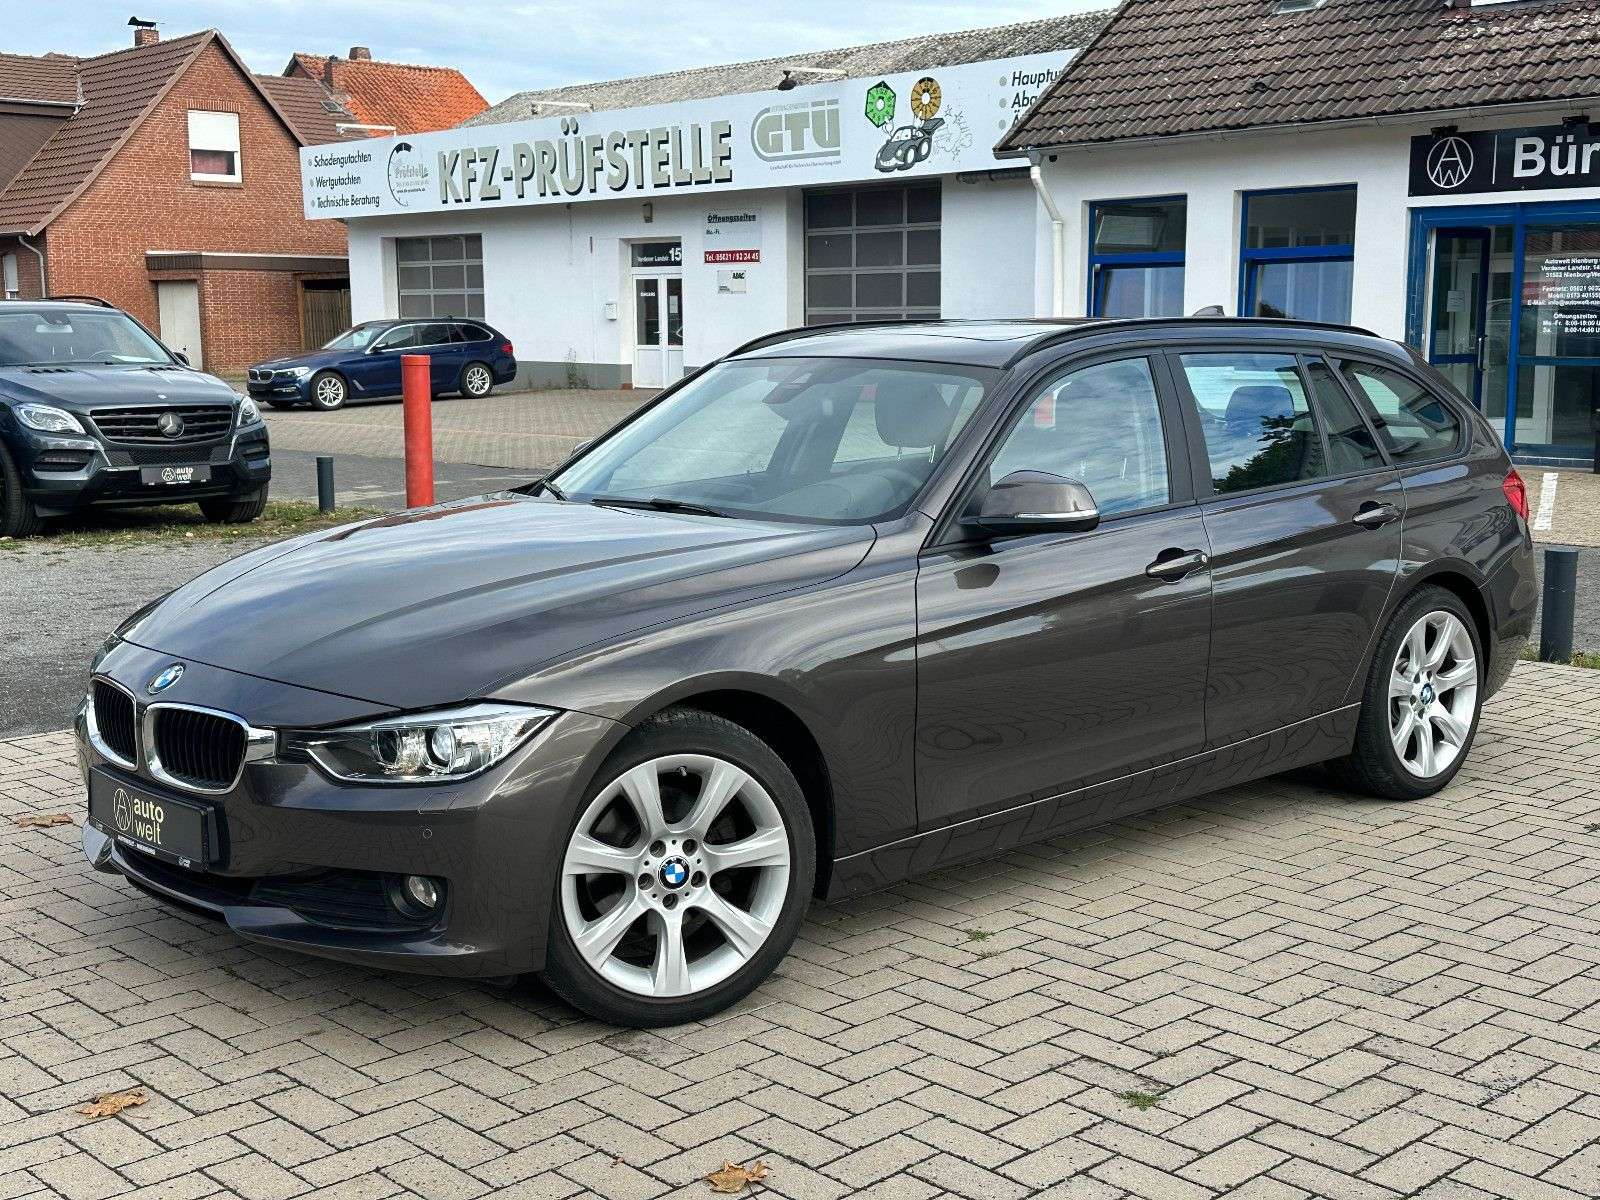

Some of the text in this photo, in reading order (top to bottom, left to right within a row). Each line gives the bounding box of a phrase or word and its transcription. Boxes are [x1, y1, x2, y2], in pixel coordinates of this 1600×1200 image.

[314, 150, 372, 168] Schadengutachten
[437, 116, 733, 205] KFZ-PRÜFSTELLE
[1512, 134, 1600, 178] Bür
[315, 172, 361, 190] Wertgutachten
[316, 193, 380, 209] Technische Beratung
[669, 247, 682, 262] 15
[133, 798, 164, 823] auto
[135, 819, 162, 844] welt
